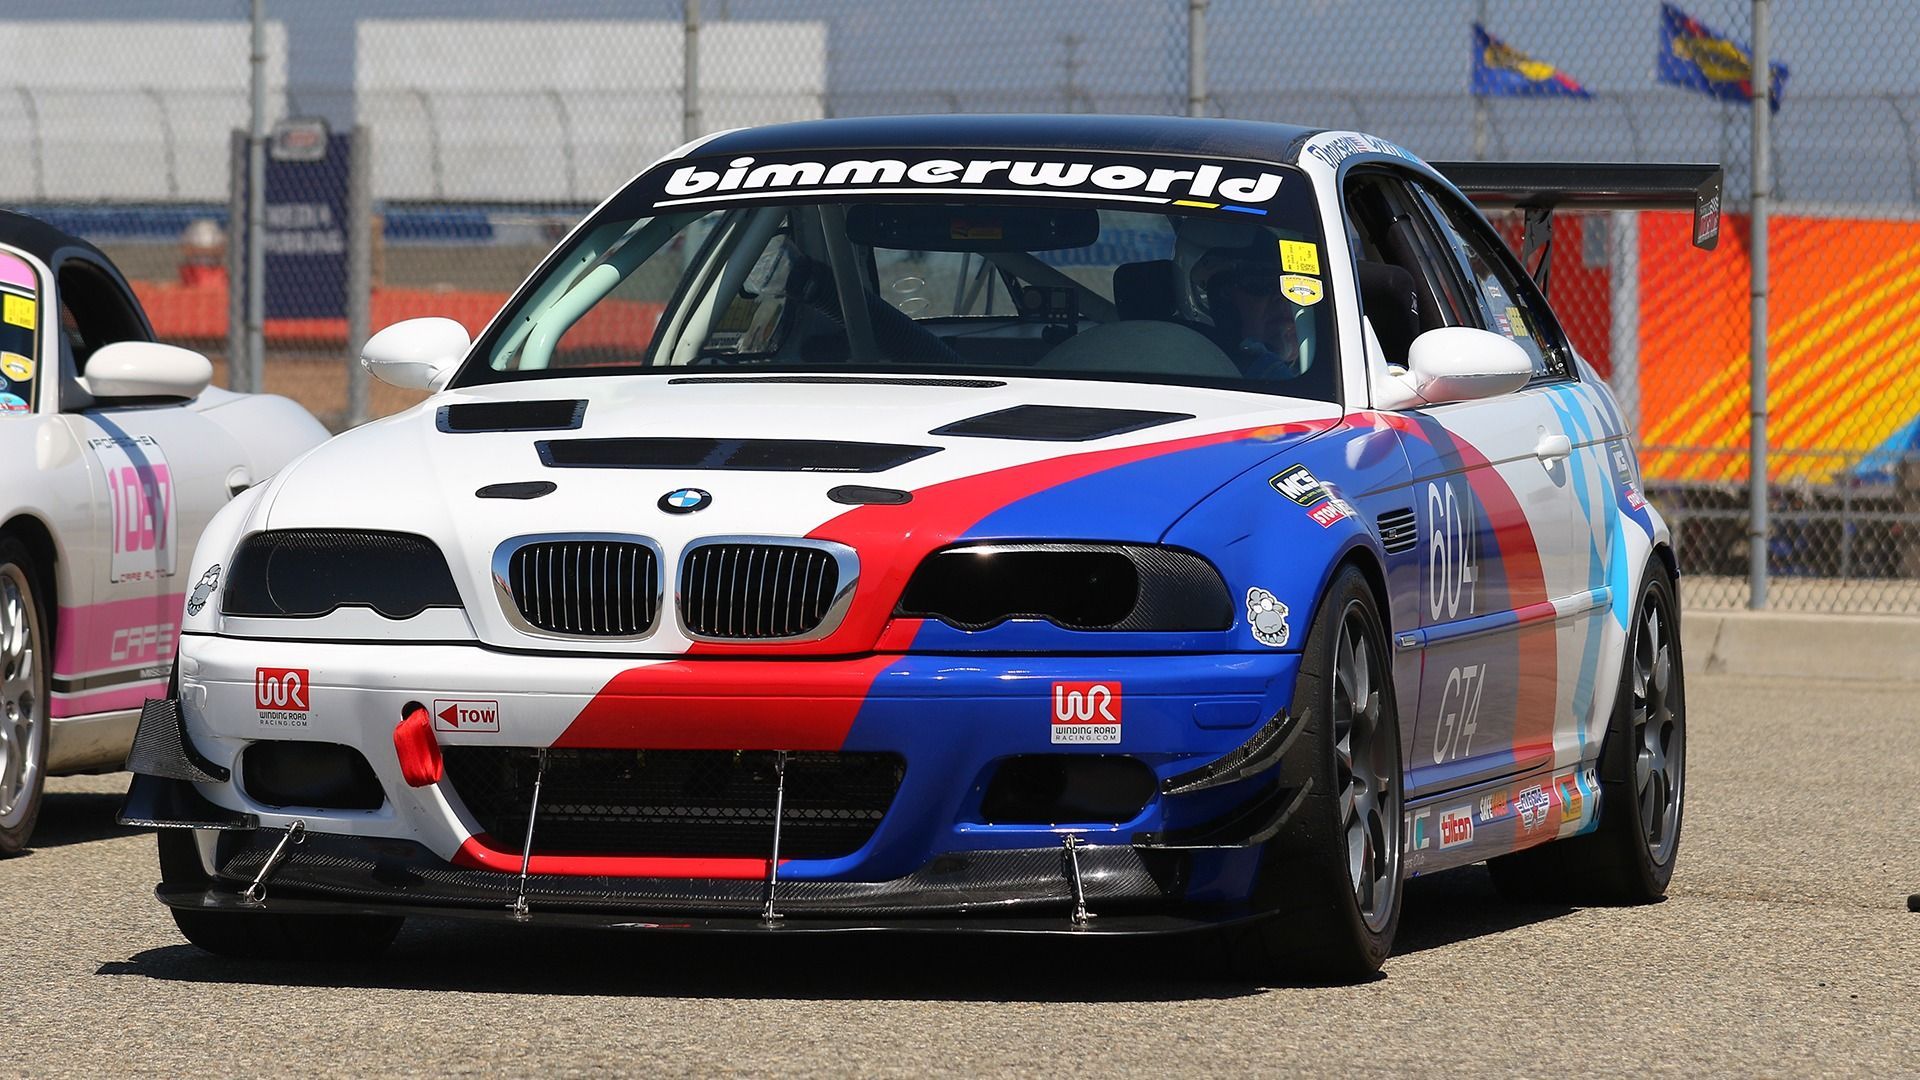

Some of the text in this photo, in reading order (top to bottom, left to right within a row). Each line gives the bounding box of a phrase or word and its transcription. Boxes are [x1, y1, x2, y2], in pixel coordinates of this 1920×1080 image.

[664, 156, 1284, 202] bimmerworld
[1276, 469, 1320, 499] MCS
[109, 463, 171, 554] 1087
[1428, 480, 1479, 621] 604
[111, 623, 175, 662] CAPE
[259, 711, 307, 721] WINDING ROAD
[260, 719, 307, 727] RACING.COM
[459, 709, 496, 723] TOW
[1055, 726, 1117, 735] WINDING ROAD
[1433, 663, 1486, 765] GT4
[1441, 812, 1473, 845] tilton
